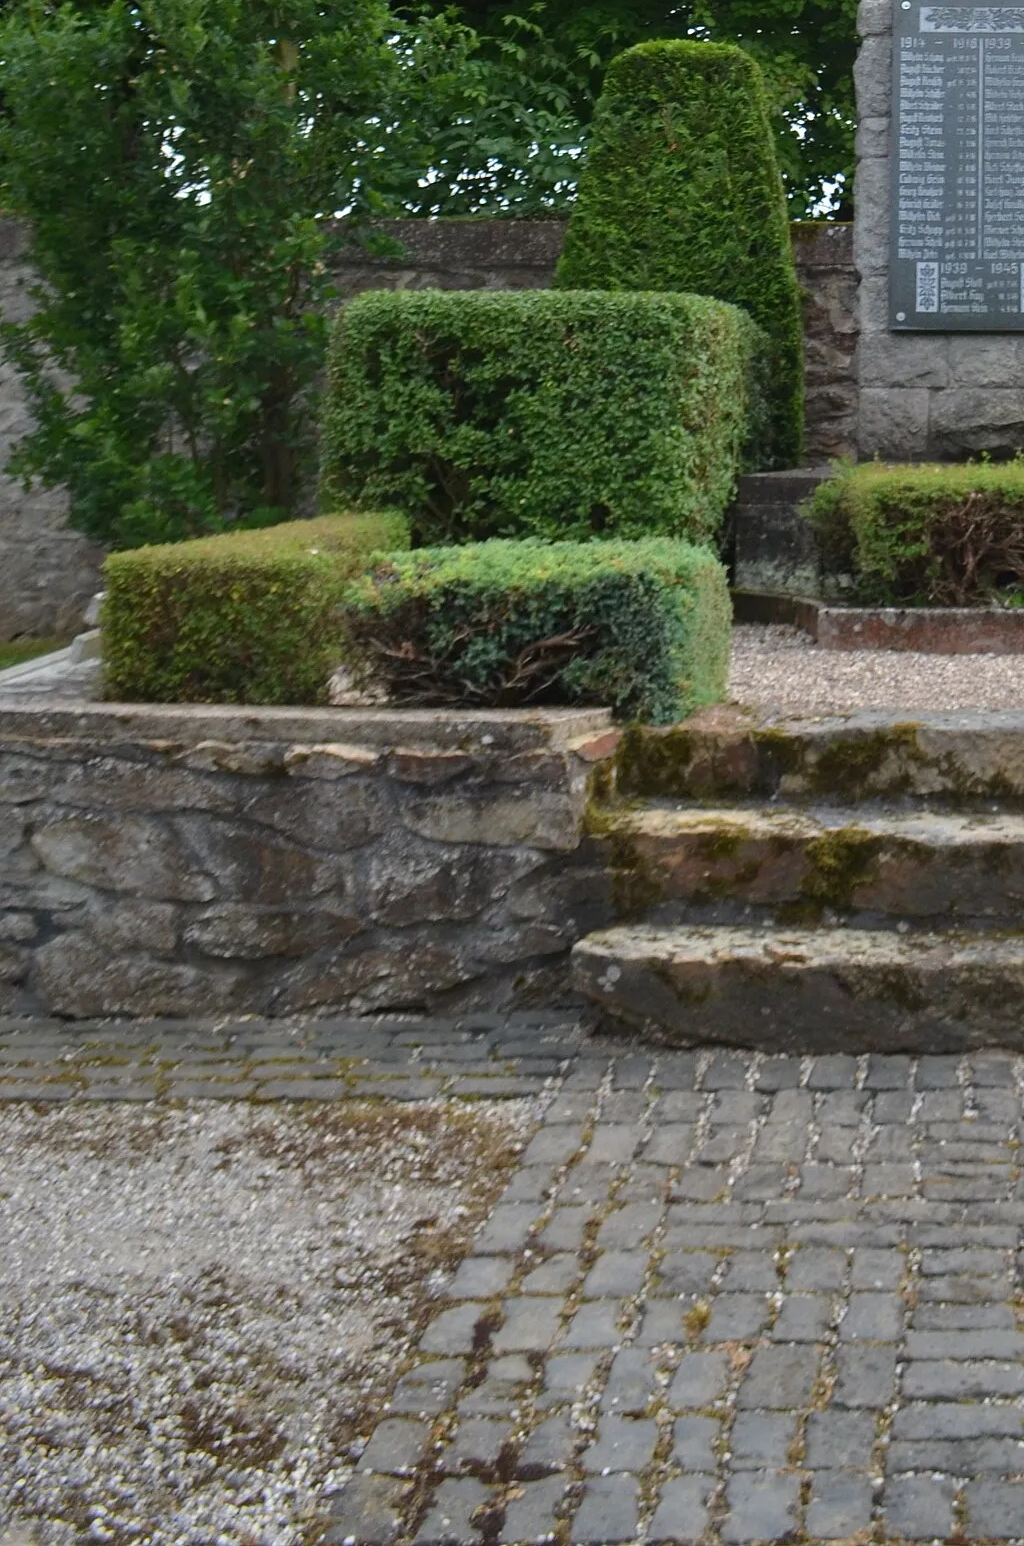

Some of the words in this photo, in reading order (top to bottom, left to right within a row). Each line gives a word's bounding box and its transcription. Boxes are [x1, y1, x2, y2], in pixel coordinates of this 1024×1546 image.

[985, 38, 1012, 49] 1939
[940, 262, 967, 274] 1939
[991, 262, 1019, 274] 1945
